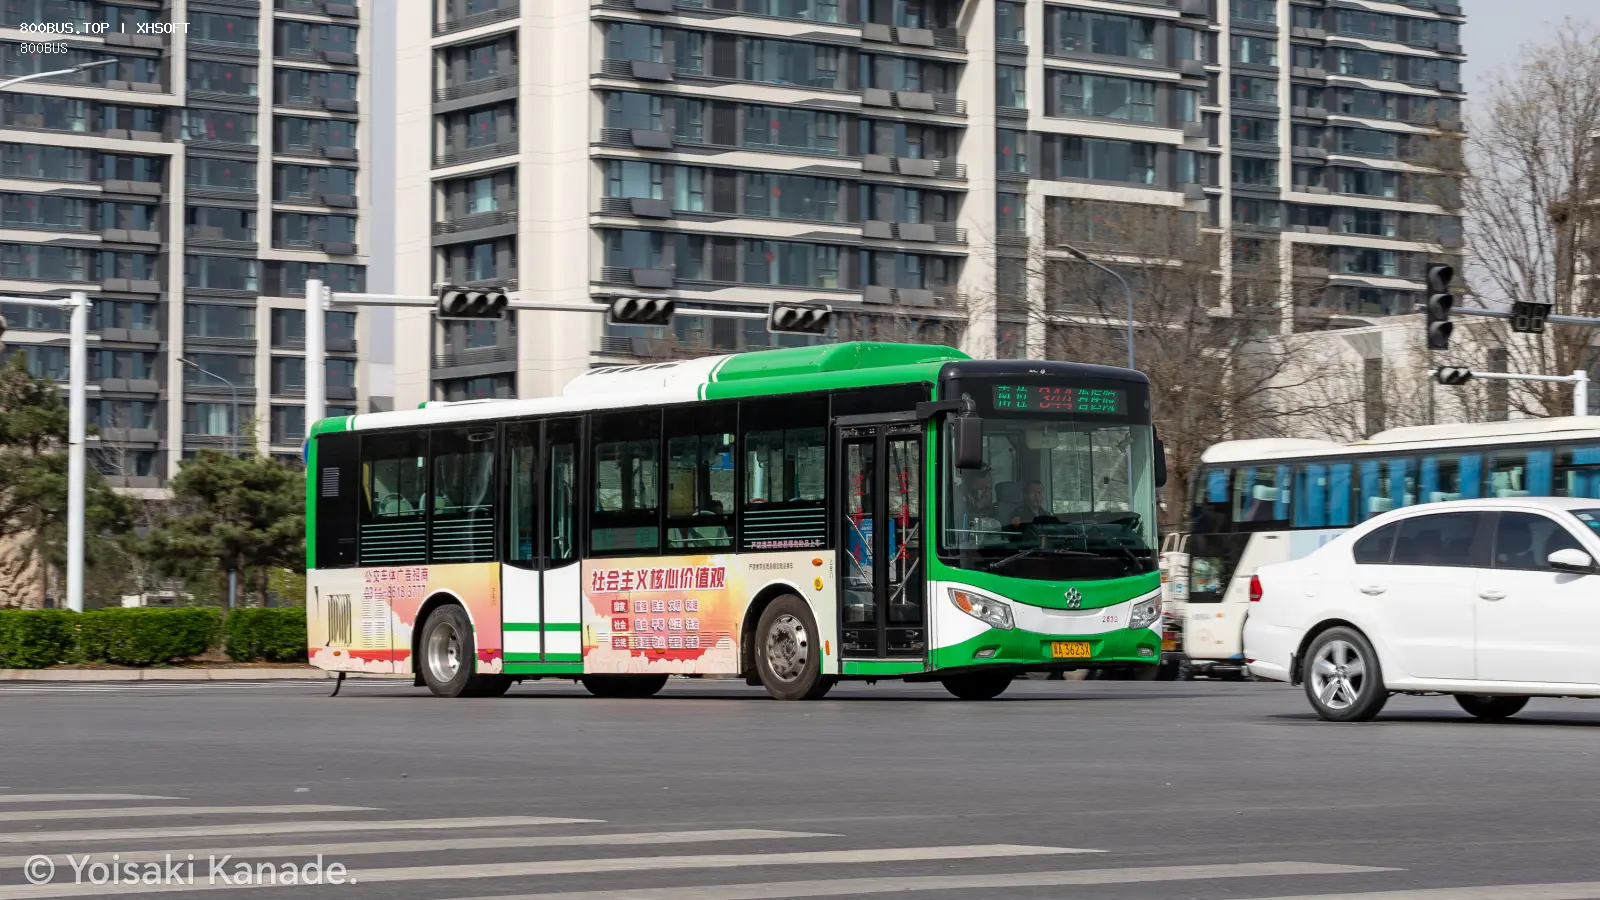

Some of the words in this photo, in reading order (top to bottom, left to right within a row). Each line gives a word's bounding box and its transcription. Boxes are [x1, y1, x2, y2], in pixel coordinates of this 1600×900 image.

[592, 567, 726, 592] 社会主义核心价值观
[651, 600, 665, 612] 民主
[613, 620, 627, 630] 社会
